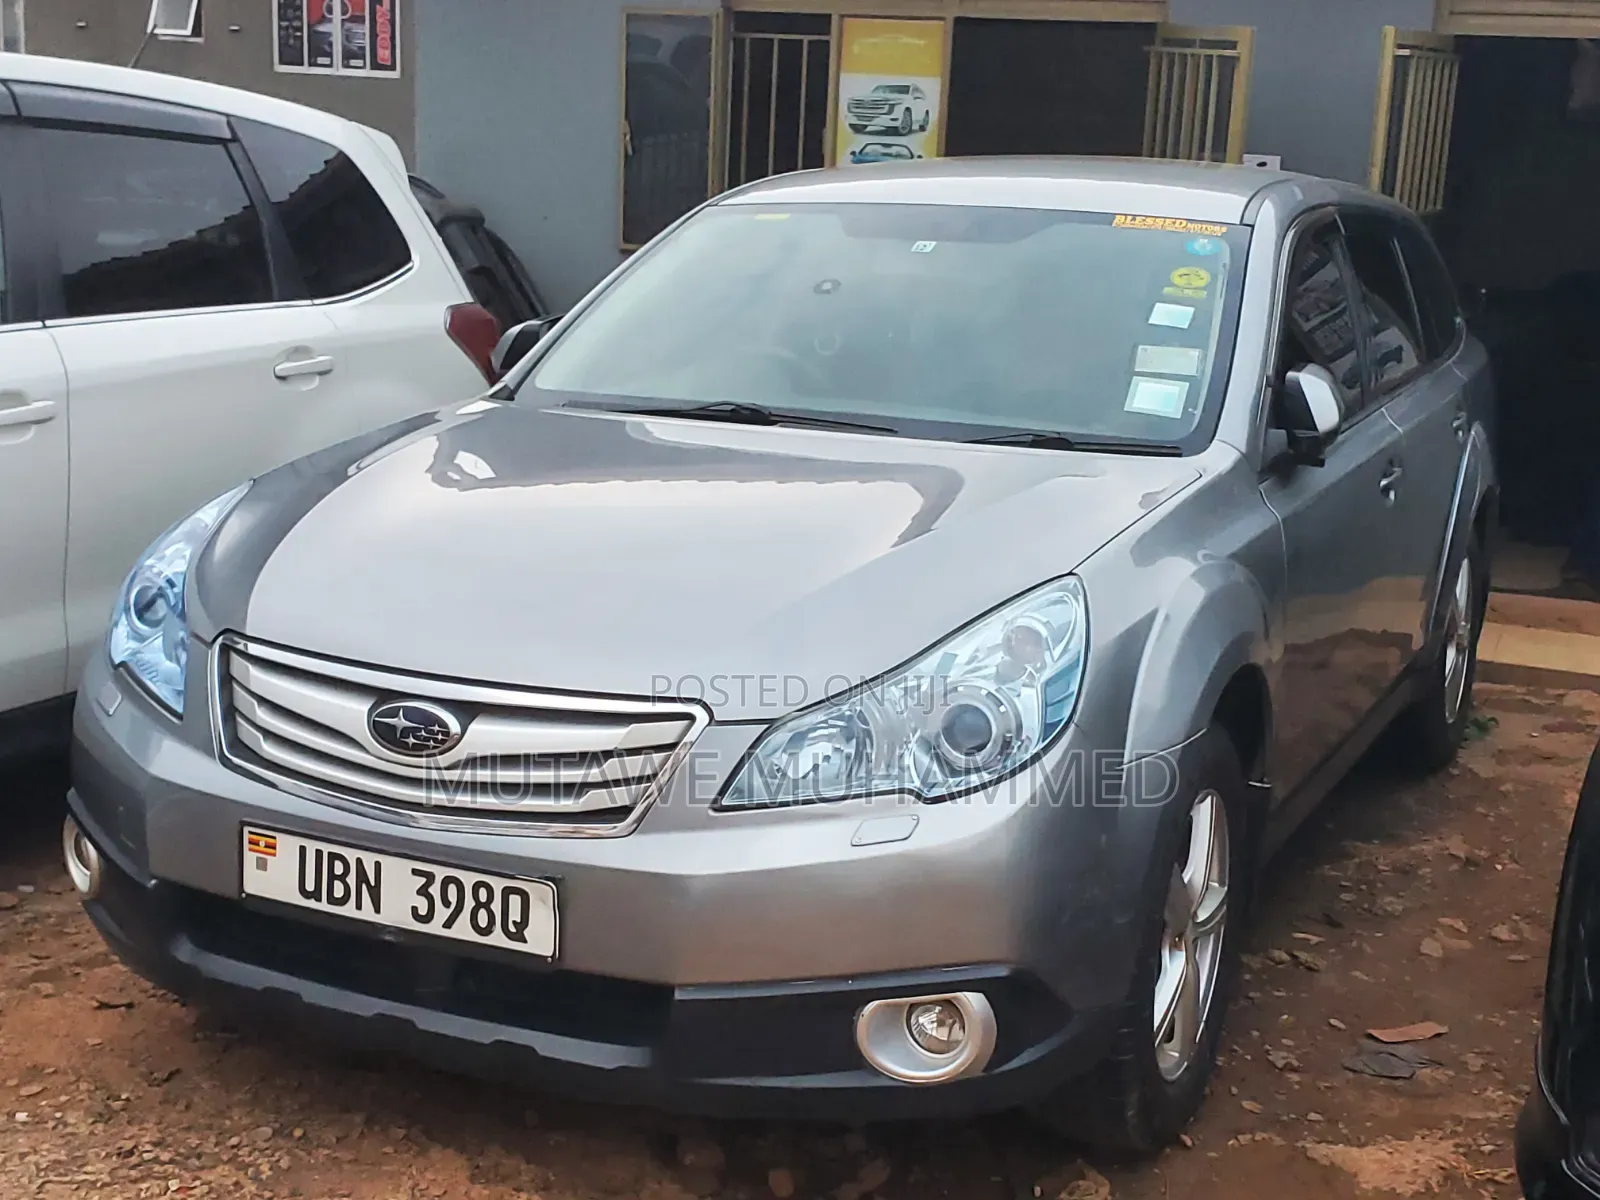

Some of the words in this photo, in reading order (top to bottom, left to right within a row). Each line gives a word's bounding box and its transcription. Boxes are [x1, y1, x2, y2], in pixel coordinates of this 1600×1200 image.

[1113, 214, 1188, 229] BLESSED
[298, 844, 382, 914] UBN
[411, 867, 531, 944] 398Q
